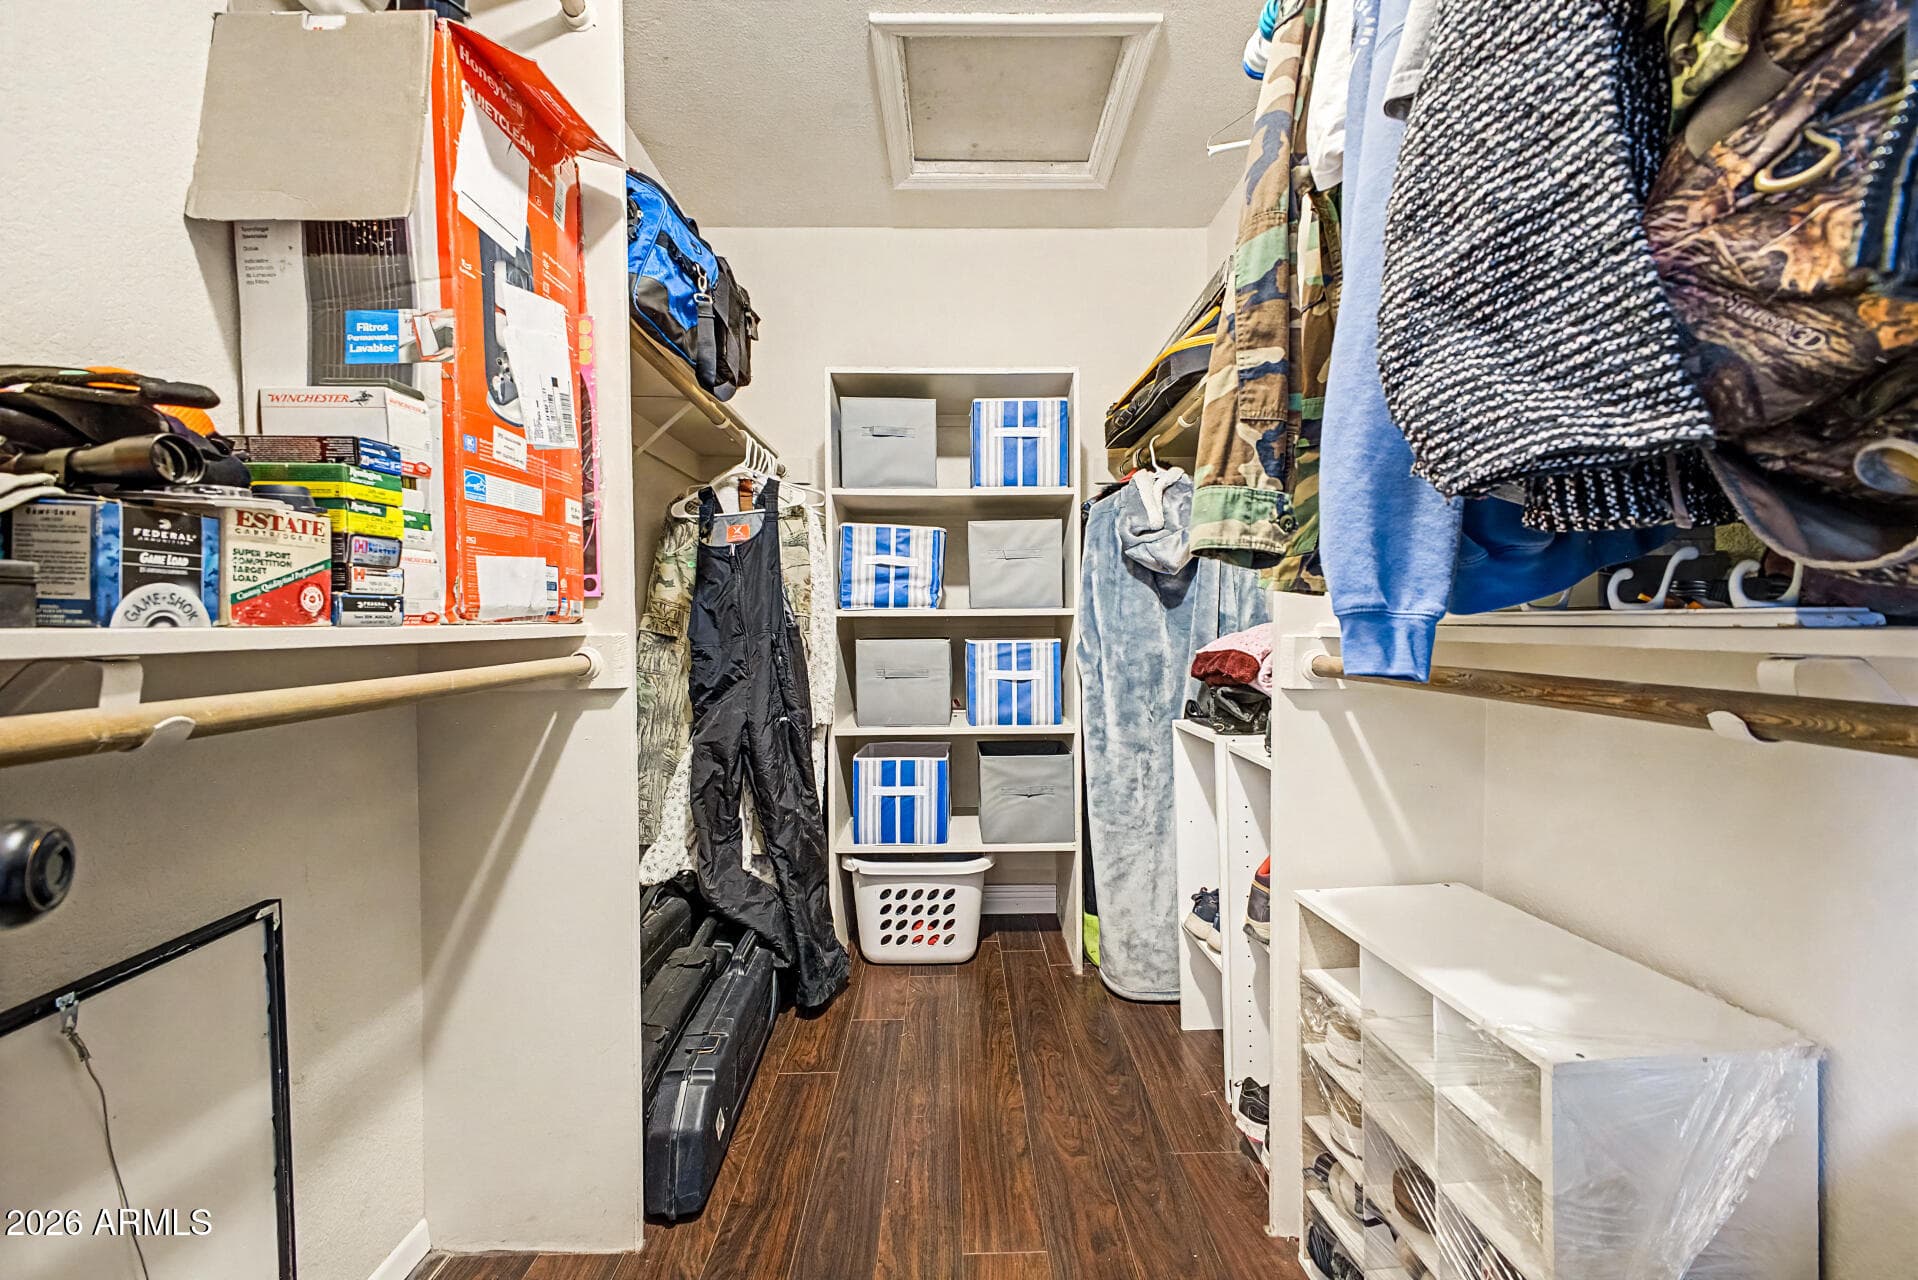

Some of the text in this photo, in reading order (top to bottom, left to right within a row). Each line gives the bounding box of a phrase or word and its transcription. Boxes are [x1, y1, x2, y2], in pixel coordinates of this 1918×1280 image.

[459, 44, 523, 117] Honeywell
[461, 79, 535, 157] QUIETCLEAN
[356, 322, 389, 332] Filtros
[268, 394, 350, 403] WINCHESTER
[235, 509, 326, 537] ESTATE
[133, 527, 194, 542] FEDERAL
[232, 548, 291, 560] SUPER SPORT
[232, 556, 292, 568] COMPETITION
[232, 565, 267, 575] TARGET
[232, 574, 259, 582] LOAD
[124, 592, 198, 622] GAME-SHOK
